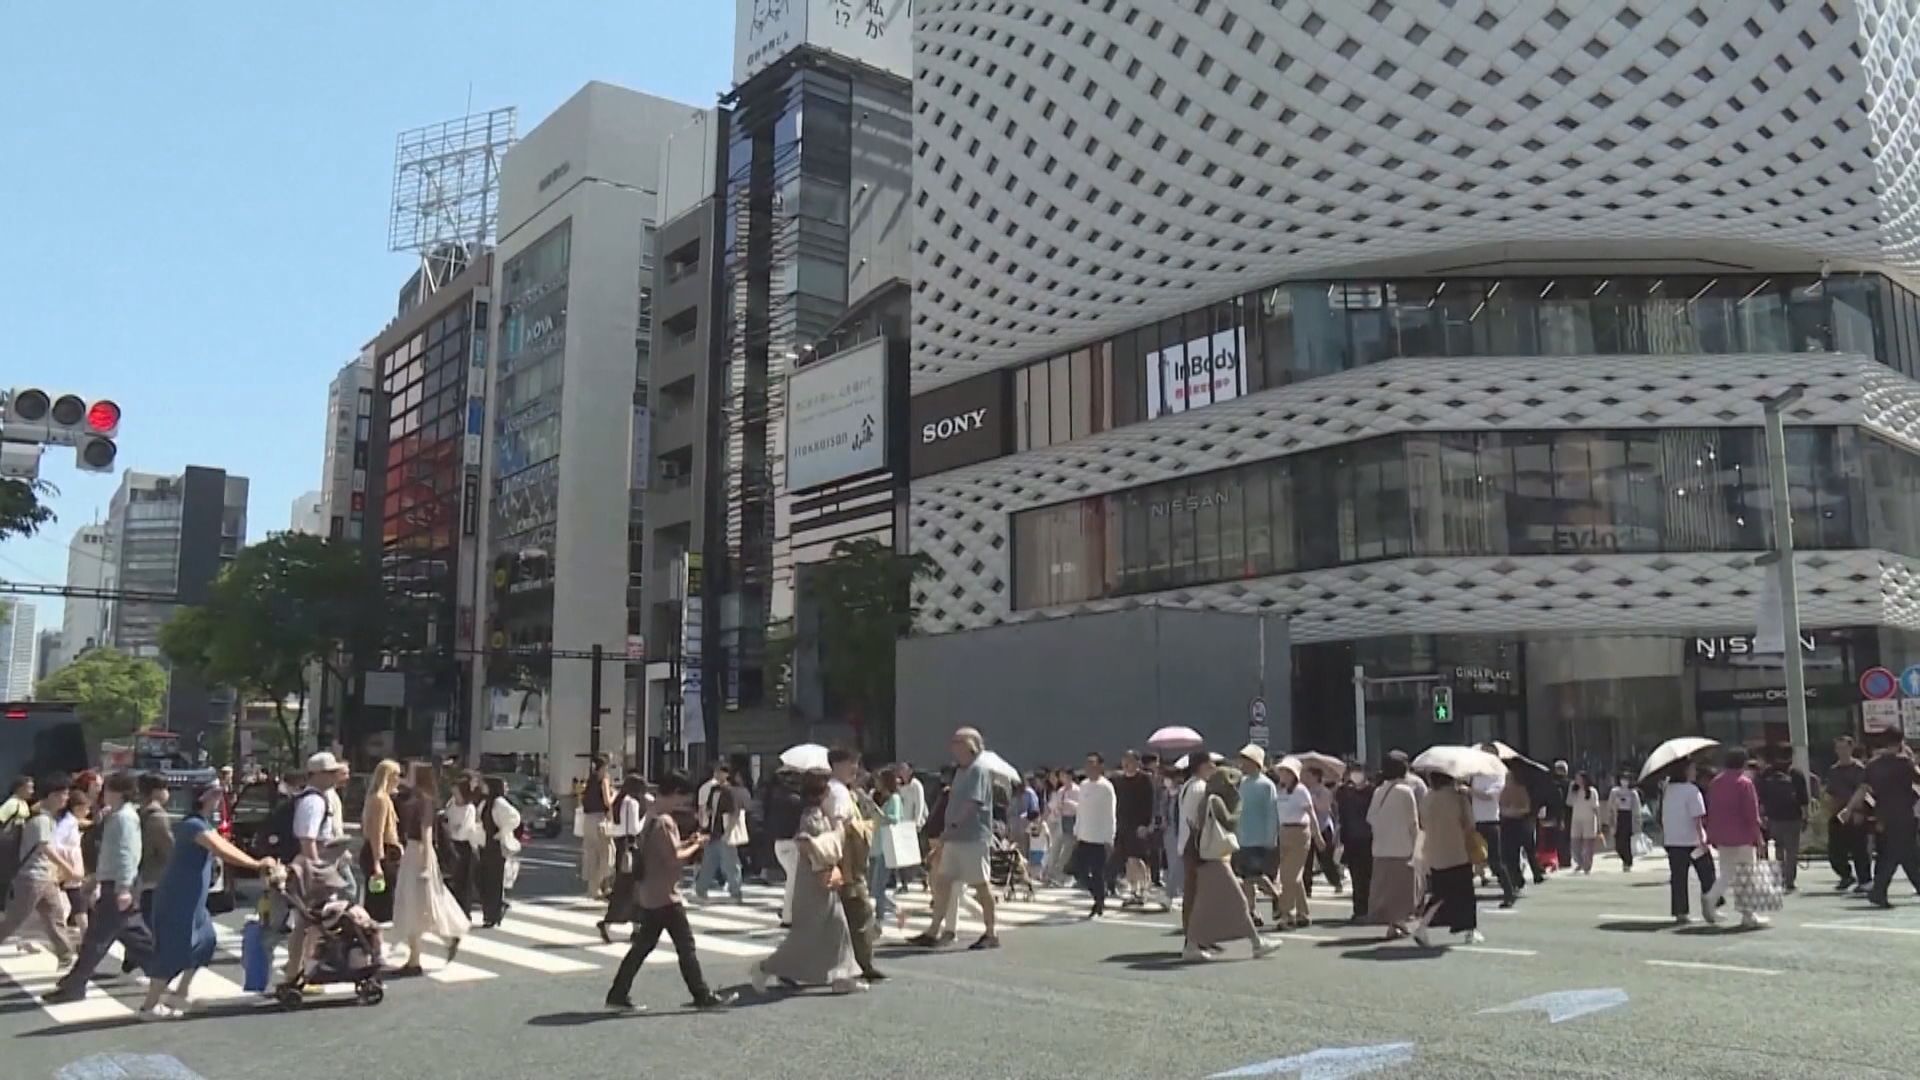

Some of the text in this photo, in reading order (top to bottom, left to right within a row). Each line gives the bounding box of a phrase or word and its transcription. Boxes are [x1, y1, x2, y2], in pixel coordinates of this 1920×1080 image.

[922, 407, 987, 443] SONY
[1151, 491, 1229, 517] NISSAN
[1696, 635, 1816, 654] NISN
